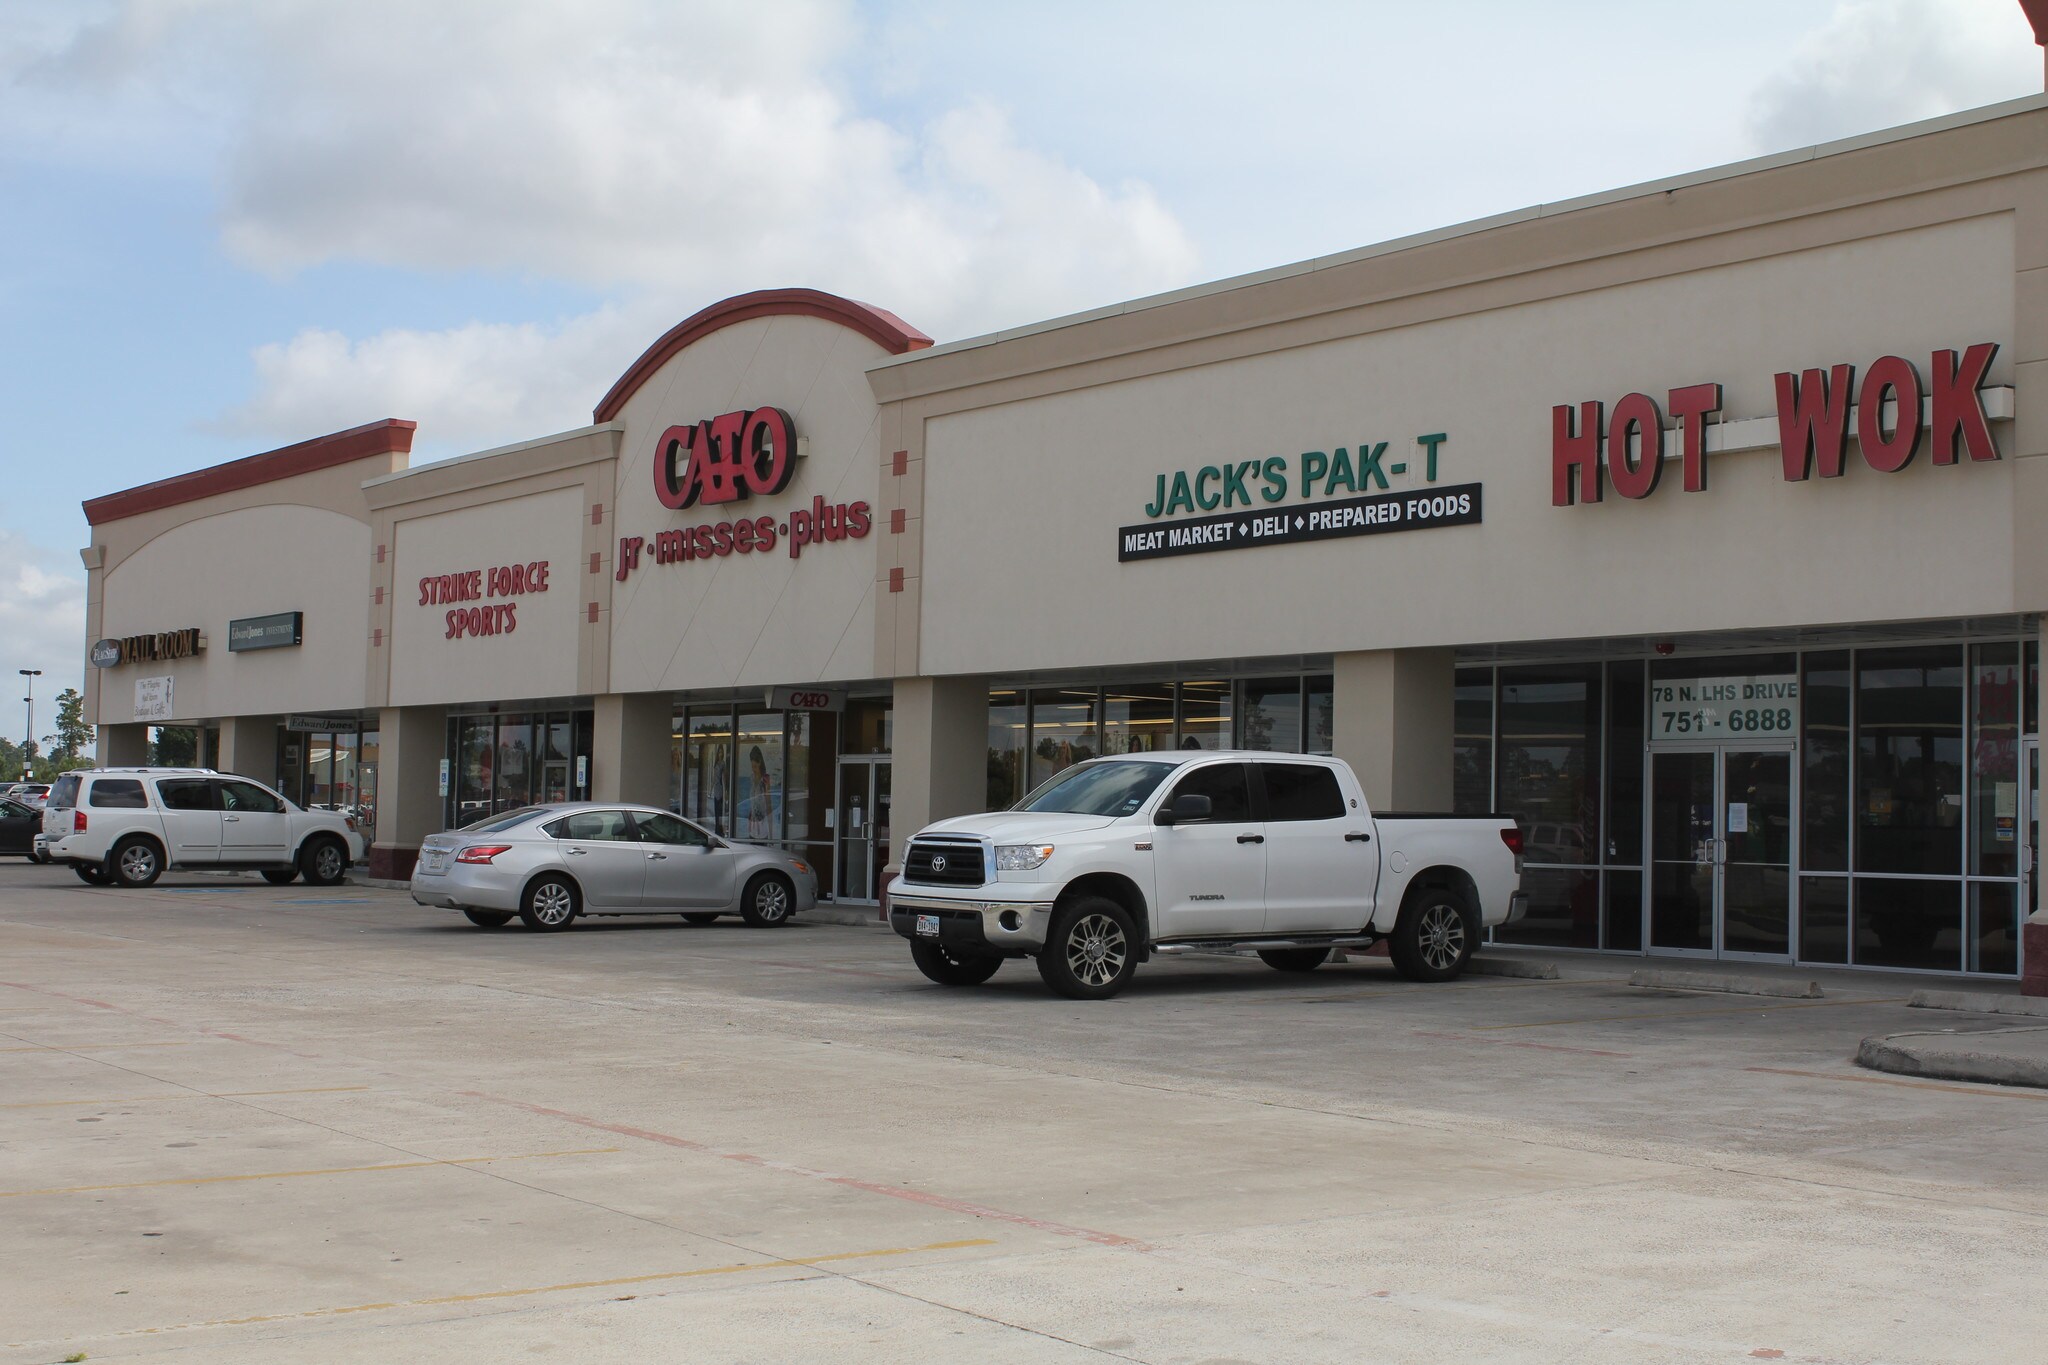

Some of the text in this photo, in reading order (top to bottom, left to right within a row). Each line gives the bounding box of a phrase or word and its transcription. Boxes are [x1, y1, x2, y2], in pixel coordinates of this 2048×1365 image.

[1552, 342, 2002, 507] HOT WOK
[653, 406, 797, 510] CATO
[1145, 456, 1287, 518] JACK'S
[616, 494, 871, 582] jr misses plus
[1125, 493, 1471, 552] MEAT MARKET DELI PREPARED FOODS
[418, 561, 549, 606] STRIKE FORCE
[445, 603, 517, 640] SPORTS
[121, 634, 155, 664] MAIL
[156, 628, 200, 660] ROOM
[790, 692, 830, 708] CATO
[1653, 682, 1798, 702] 78 N. LHS DRIVE
[1728, 708, 1792, 732] 6888
